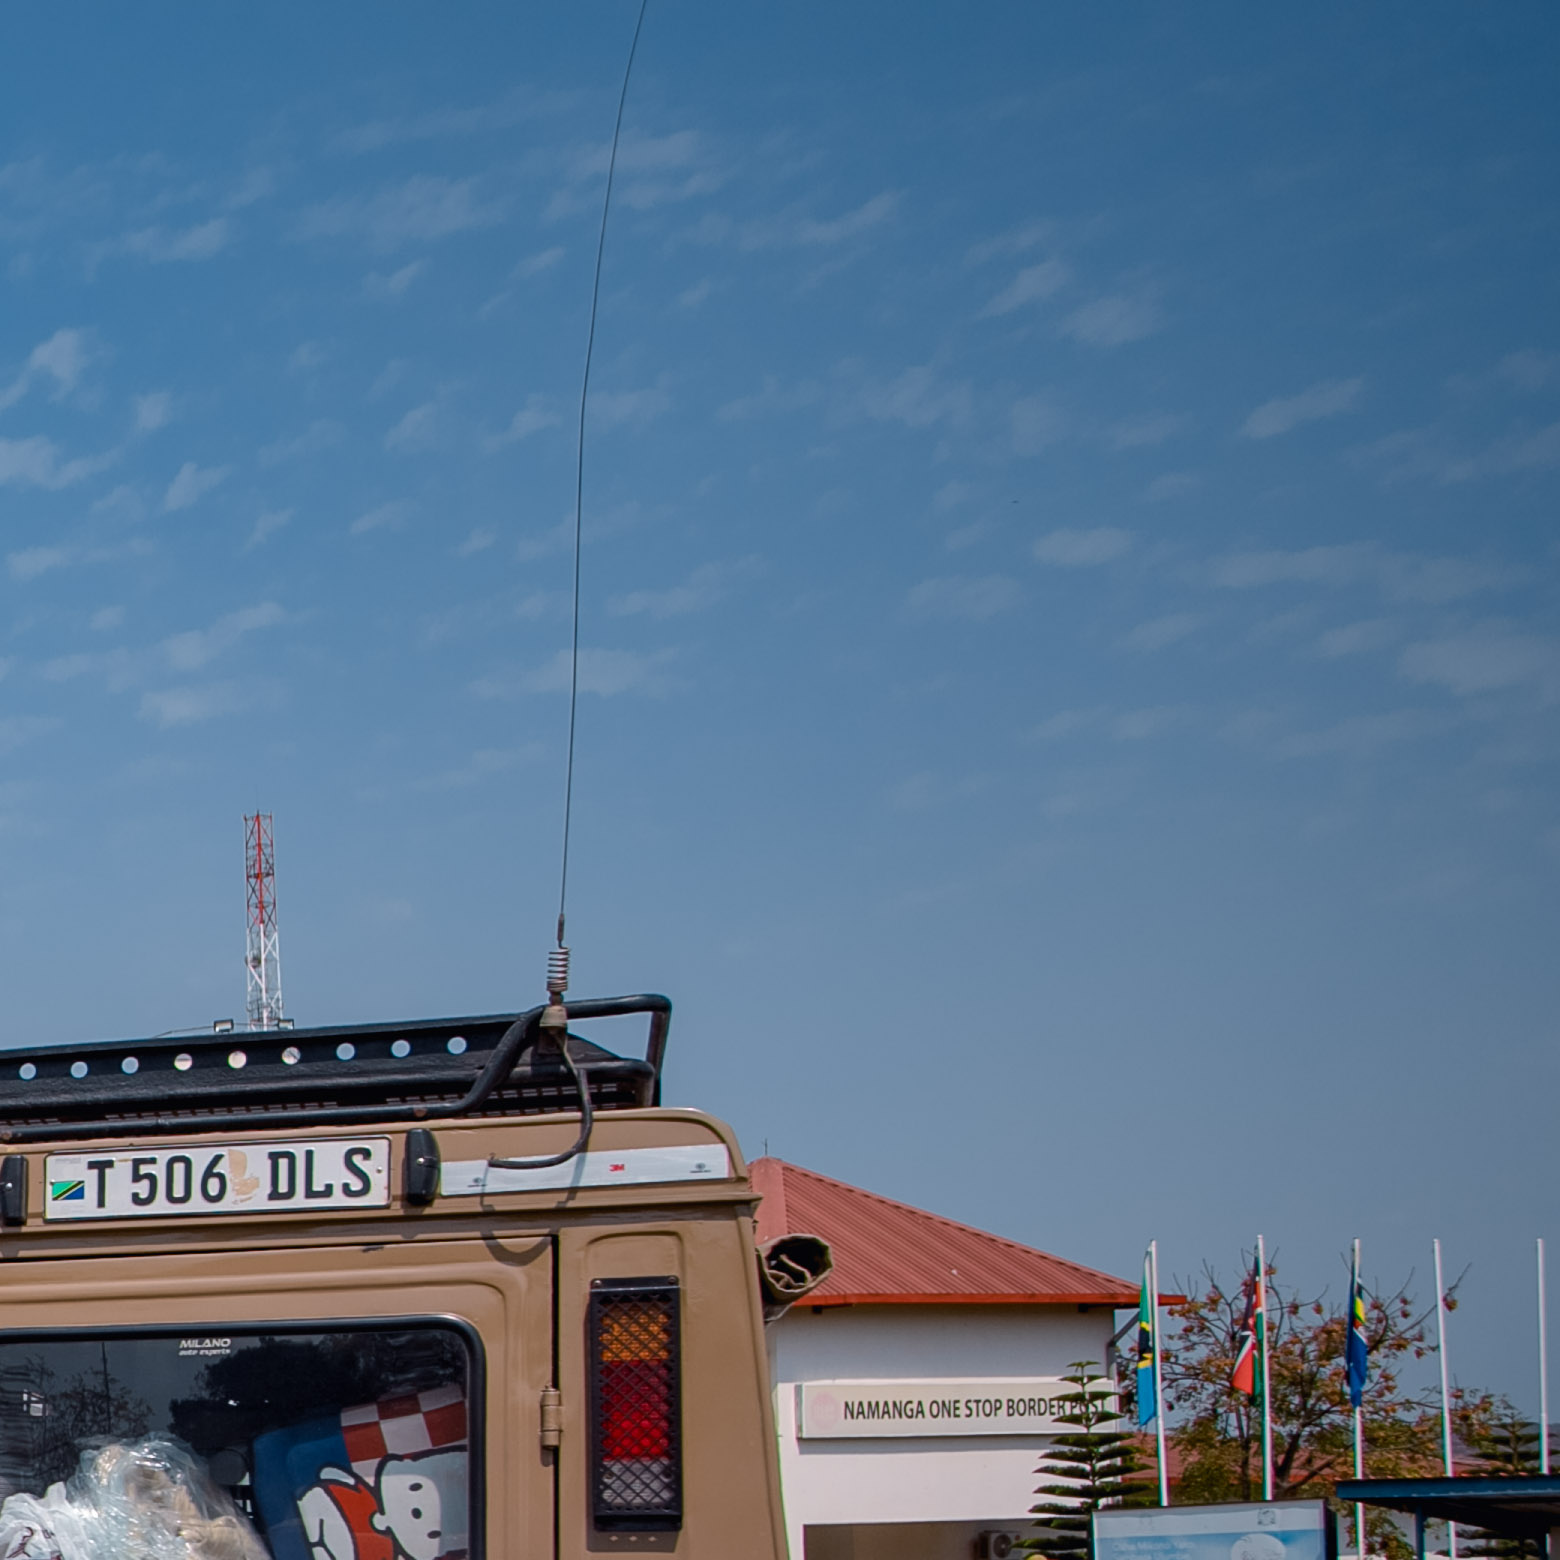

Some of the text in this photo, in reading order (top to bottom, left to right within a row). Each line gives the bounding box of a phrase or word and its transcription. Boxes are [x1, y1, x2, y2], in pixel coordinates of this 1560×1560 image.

[268, 1148, 372, 1200] DLS
[610, 1164, 624, 1172] 3M
[179, 1338, 232, 1348] MILANO
[844, 1400, 925, 1420] NAMANGA
[930, 1400, 960, 1418] ONE
[965, 1399, 1002, 1418] STOP
[1007, 1398, 1065, 1417] BORDER
